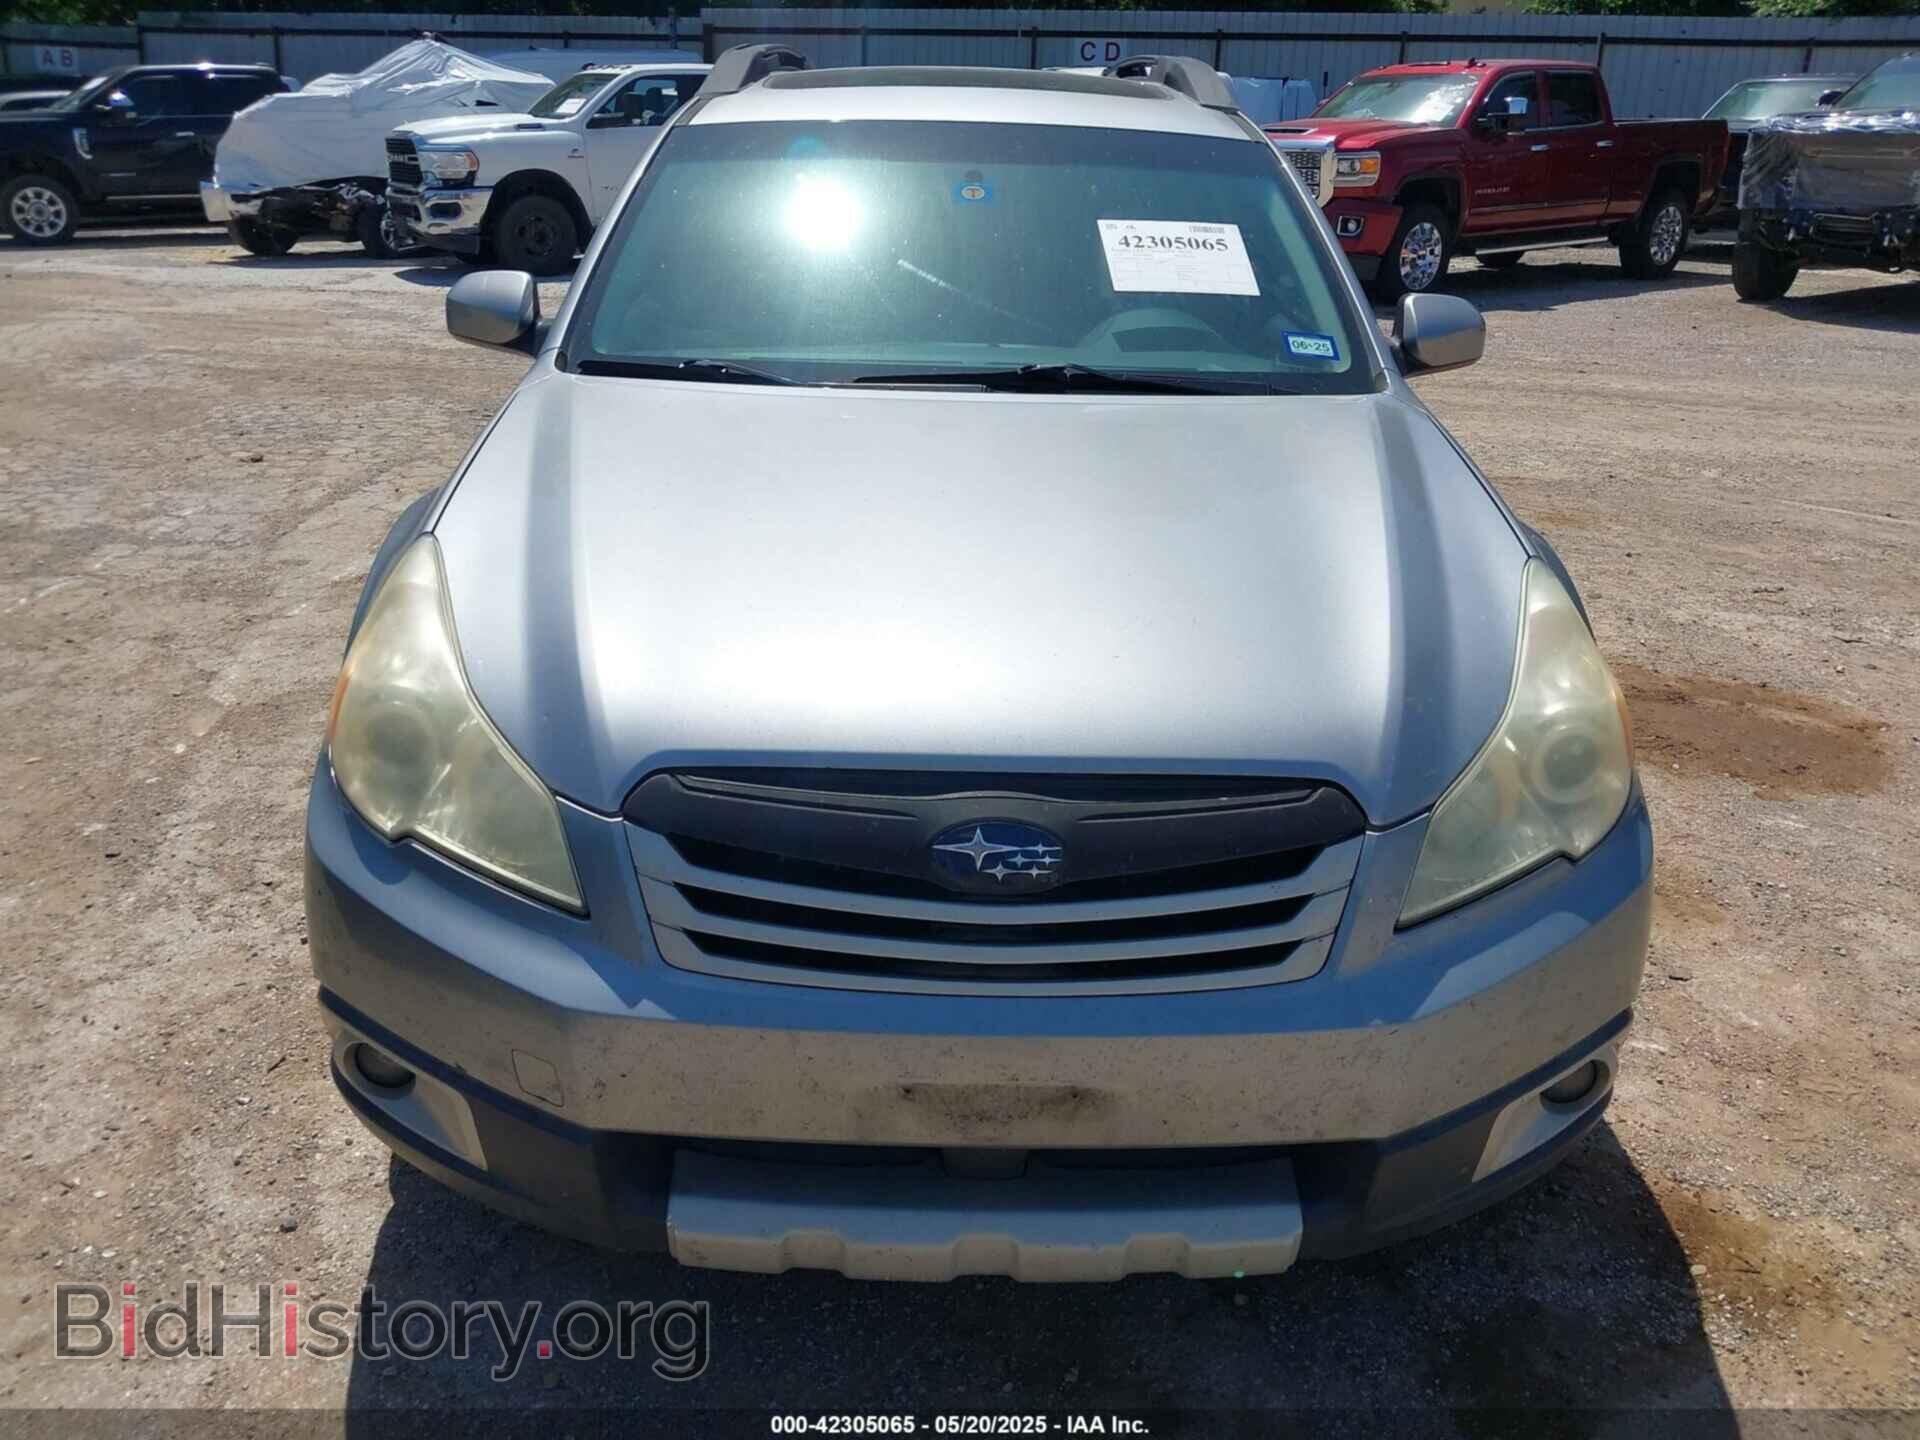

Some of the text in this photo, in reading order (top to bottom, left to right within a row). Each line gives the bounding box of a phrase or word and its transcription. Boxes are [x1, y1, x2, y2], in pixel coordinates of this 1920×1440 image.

[1081, 41, 1120, 61] C D
[1118, 235, 1229, 251] 42305065
